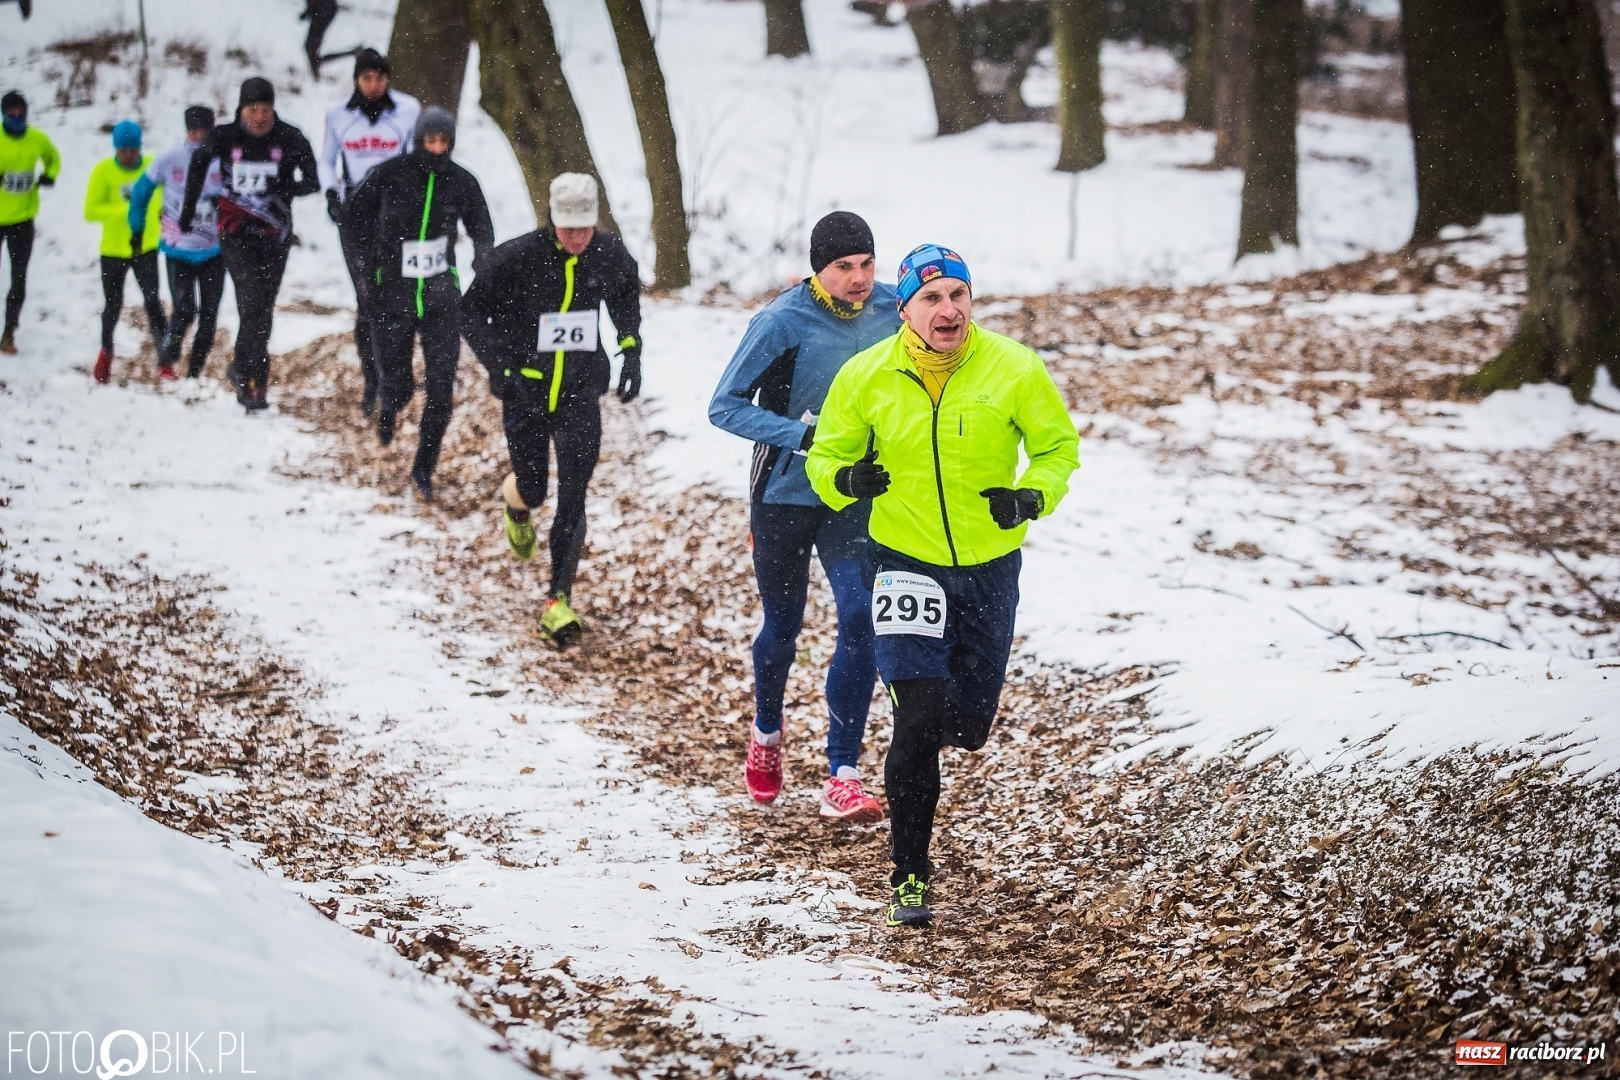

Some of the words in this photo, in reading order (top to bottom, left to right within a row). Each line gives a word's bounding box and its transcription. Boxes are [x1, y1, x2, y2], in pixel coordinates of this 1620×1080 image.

[237, 174, 263, 188] 27
[552, 327, 584, 344] 26
[876, 594, 942, 625] 295
